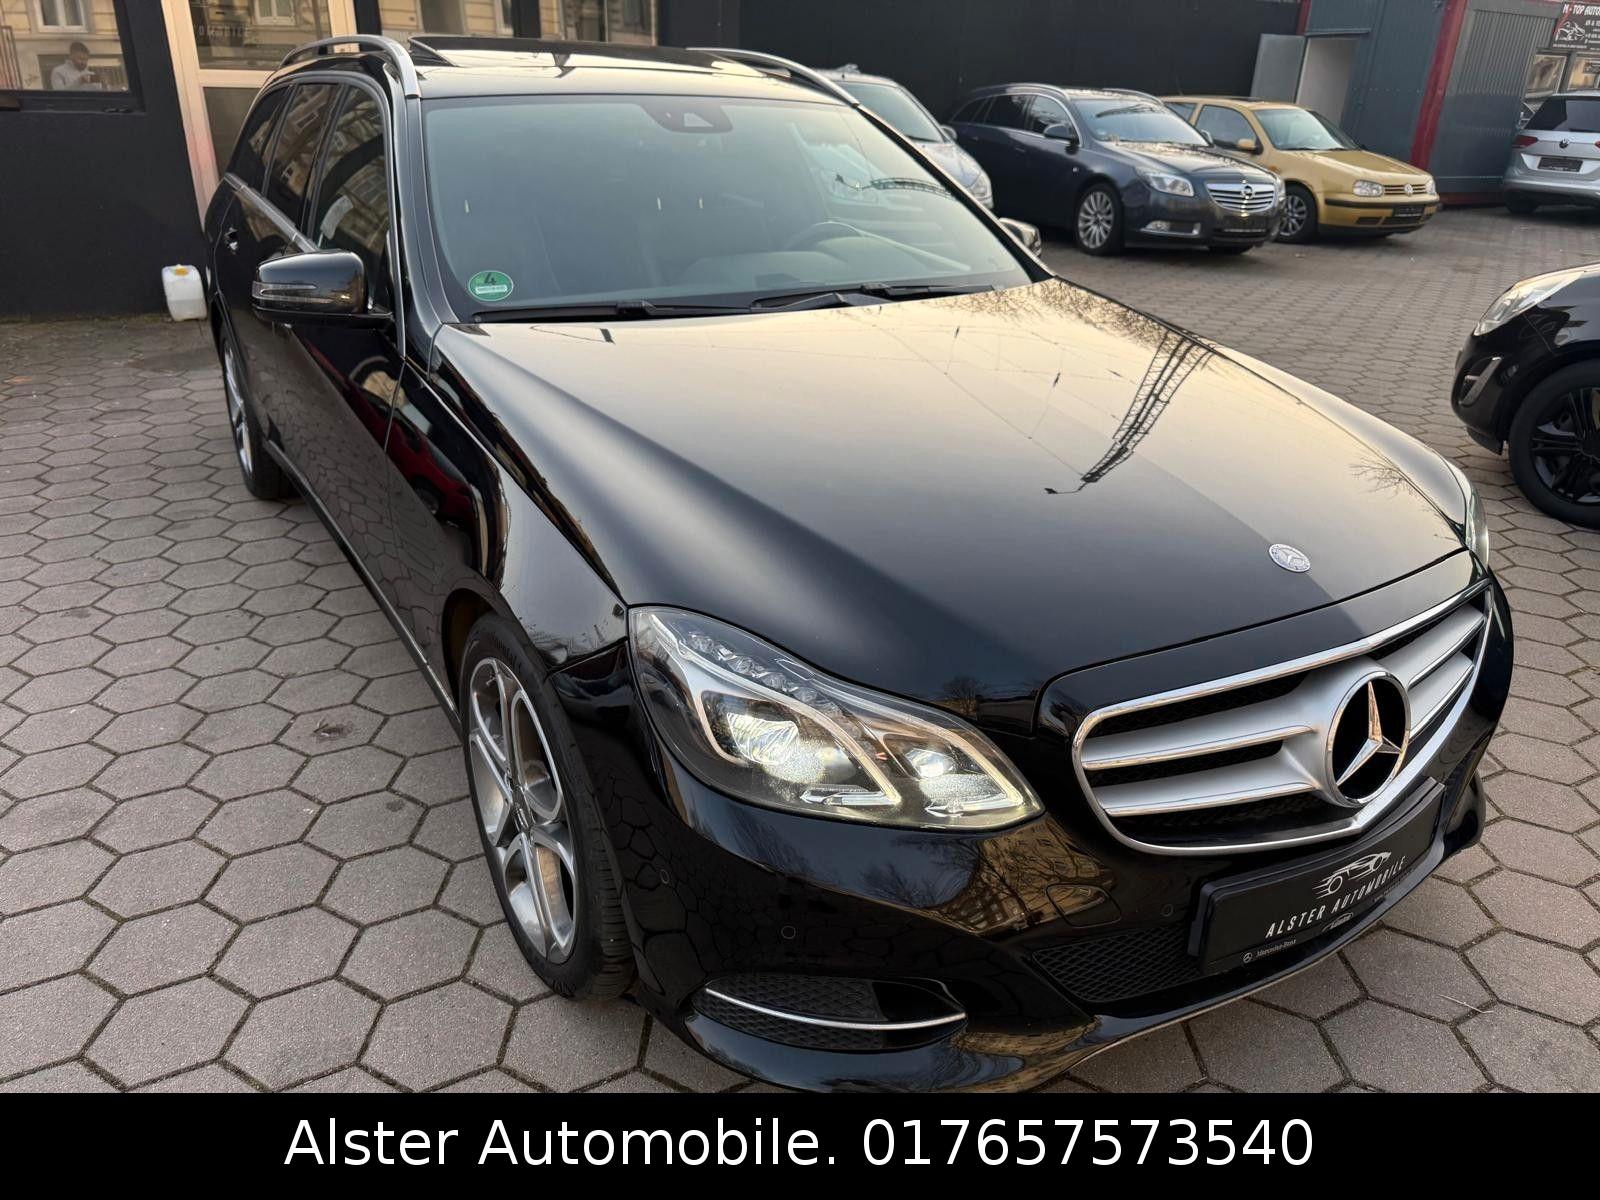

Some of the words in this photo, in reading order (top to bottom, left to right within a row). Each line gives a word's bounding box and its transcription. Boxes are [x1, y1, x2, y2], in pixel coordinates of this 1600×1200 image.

[1572, 4, 1585, 15] TOP
[484, 271, 497, 286] 4
[1265, 905, 1326, 938] ALSTER
[1331, 855, 1406, 914] AUTOMOBILE
